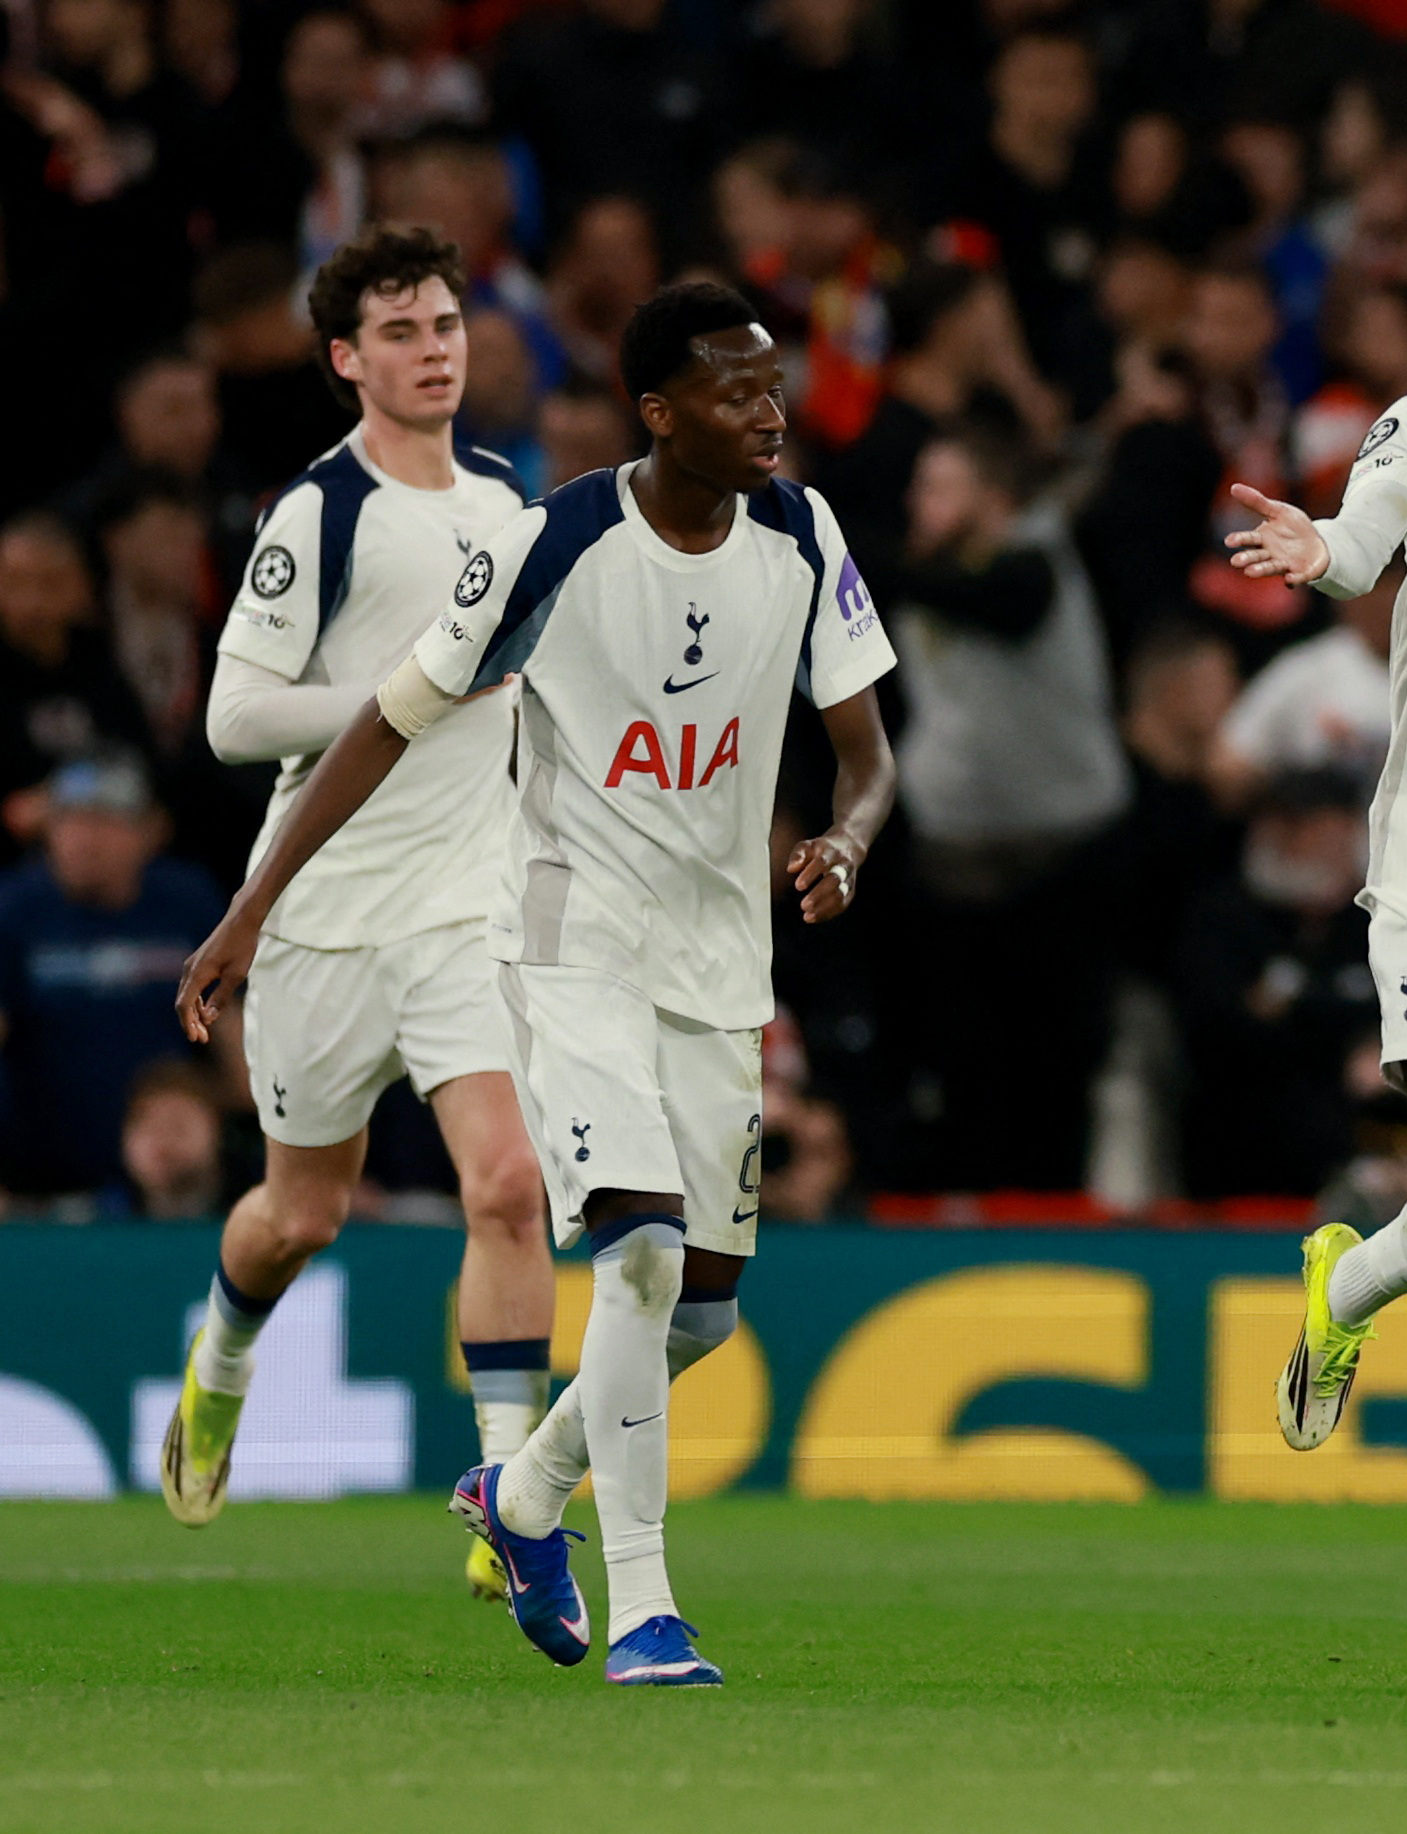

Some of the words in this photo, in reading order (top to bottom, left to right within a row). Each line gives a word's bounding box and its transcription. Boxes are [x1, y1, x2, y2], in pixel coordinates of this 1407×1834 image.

[847, 608, 881, 642] krak
[603, 716, 740, 791] AIA
[739, 1113, 761, 1195] 2
